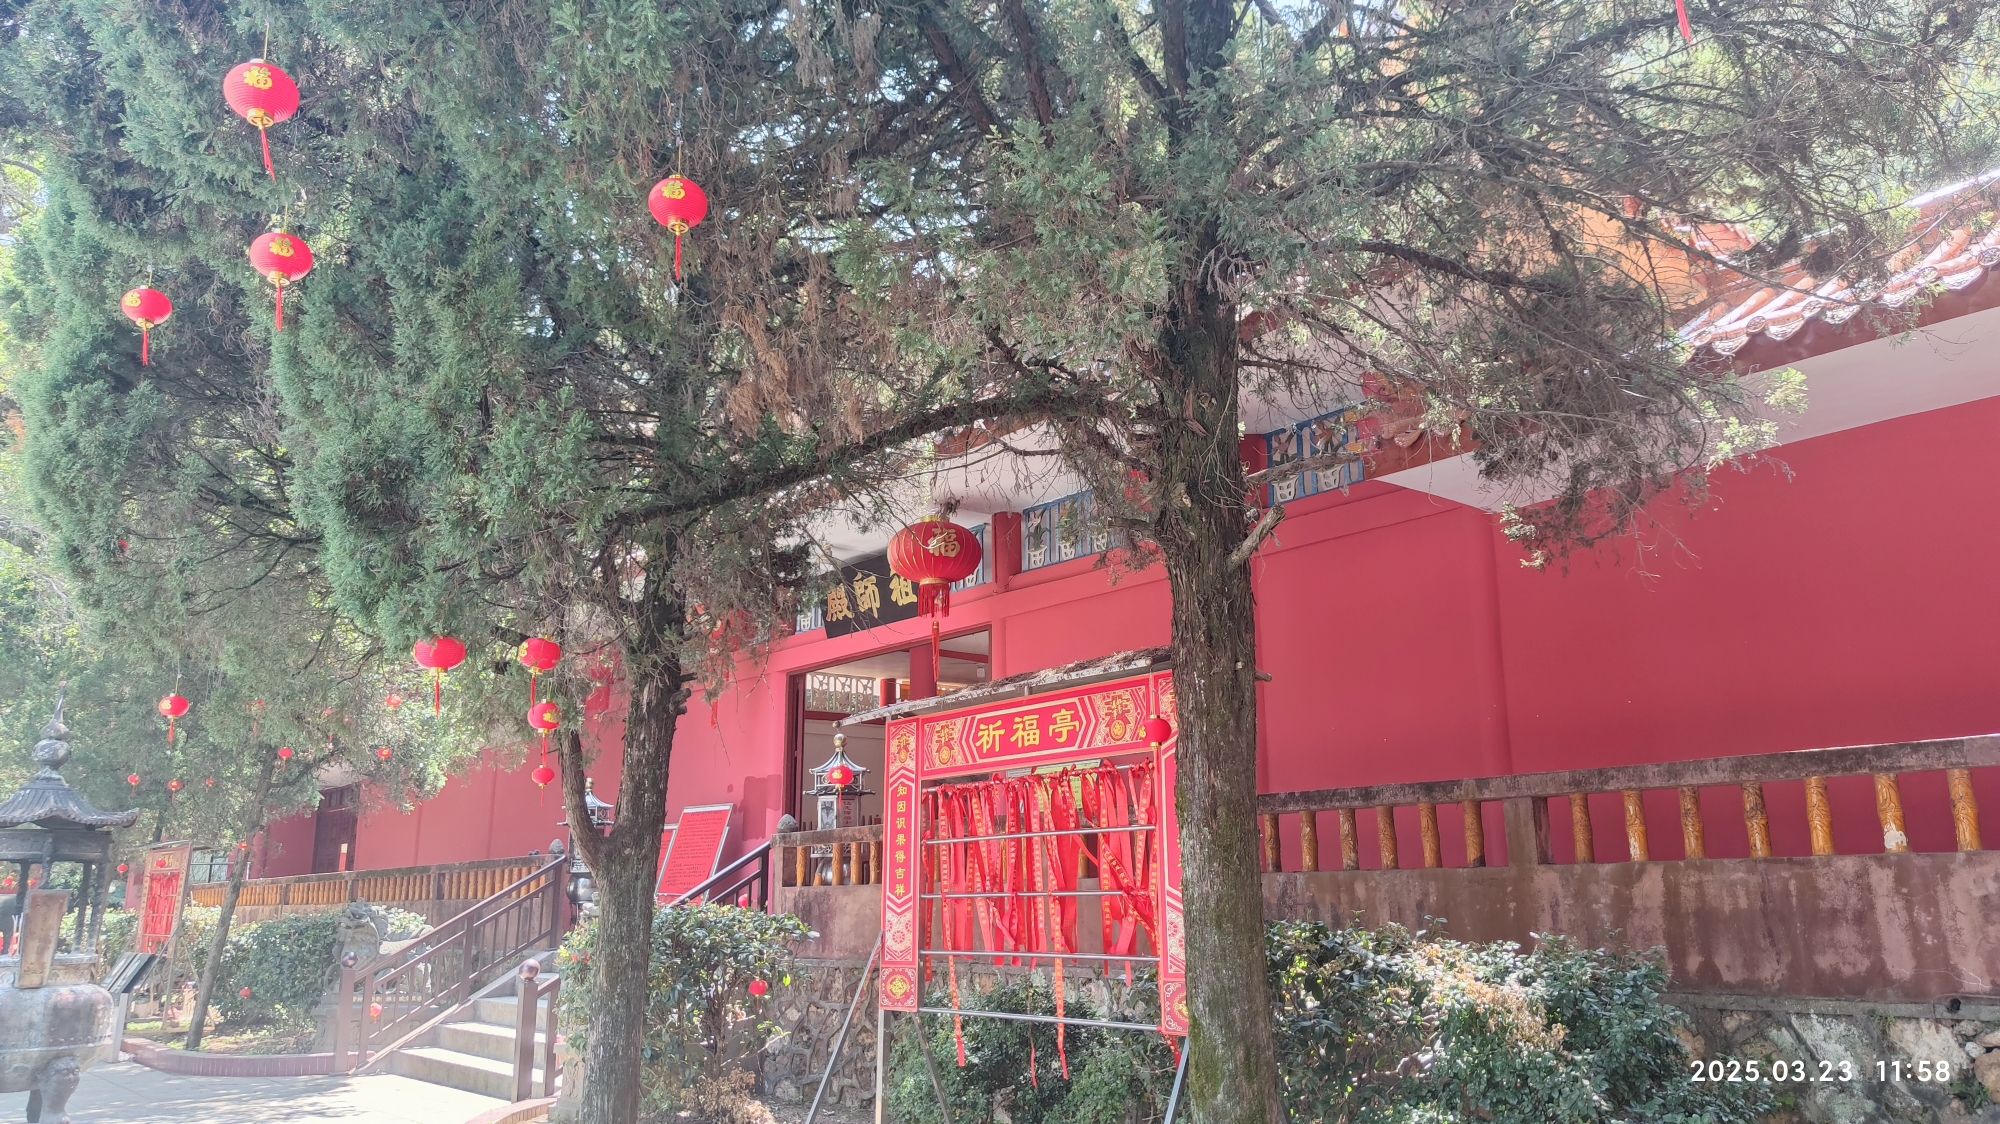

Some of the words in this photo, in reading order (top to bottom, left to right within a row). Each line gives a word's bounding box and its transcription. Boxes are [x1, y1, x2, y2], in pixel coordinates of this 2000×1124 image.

[927, 528, 960, 558] 福
[975, 708, 1080, 754] 祈福亭
[894, 784, 908, 897] 知因识果得吉祥
